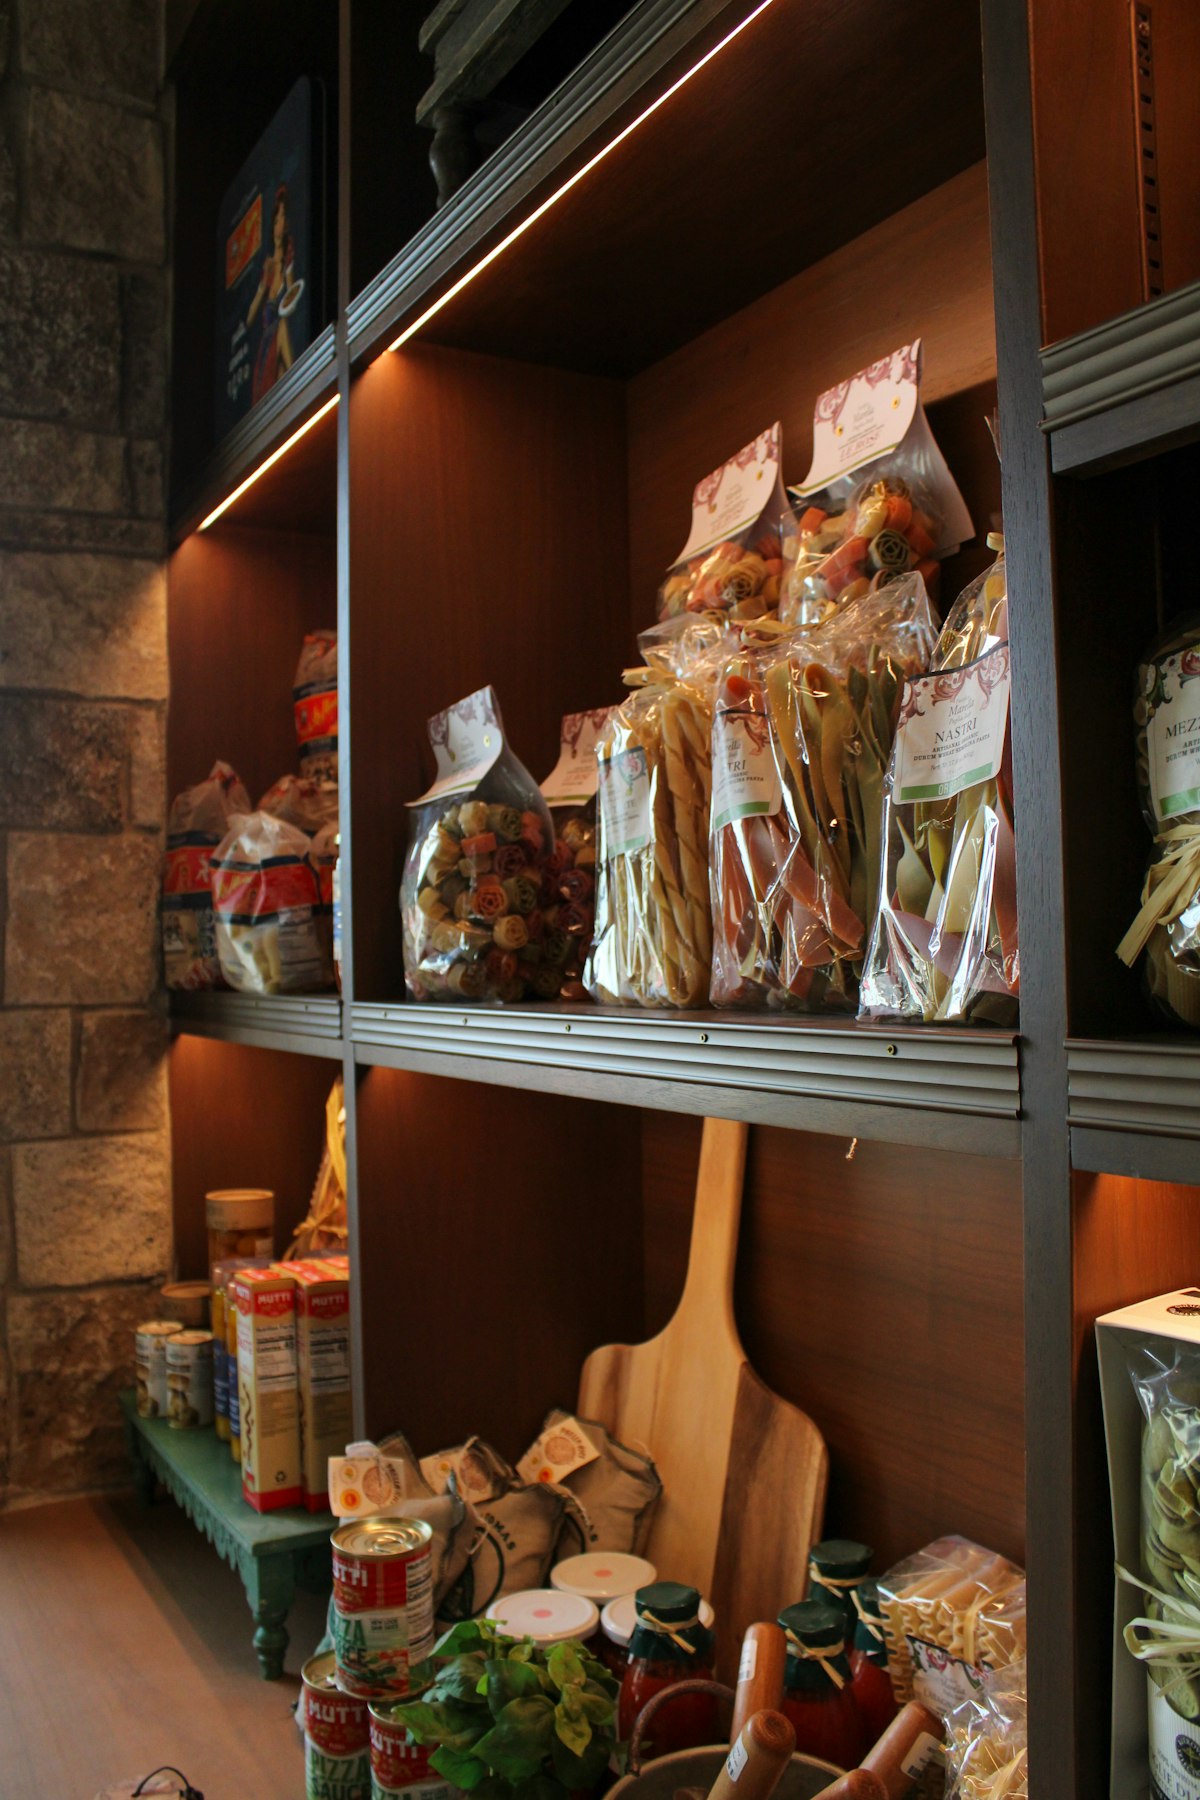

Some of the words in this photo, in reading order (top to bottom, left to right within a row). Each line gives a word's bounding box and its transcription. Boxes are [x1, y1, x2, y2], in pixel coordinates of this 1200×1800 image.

[934, 717, 977, 744] NASTRI
[1165, 717, 1200, 740] MEZ
[913, 752, 937, 761] DURUM
[976, 733, 990, 744] PASTA
[1165, 750, 1188, 762] DURUM
[257, 1290, 291, 1305] MUTTI
[311, 1294, 345, 1307] MUTTI
[332, 1562, 368, 1588] UTTI
[309, 1697, 366, 1724] MUTT
